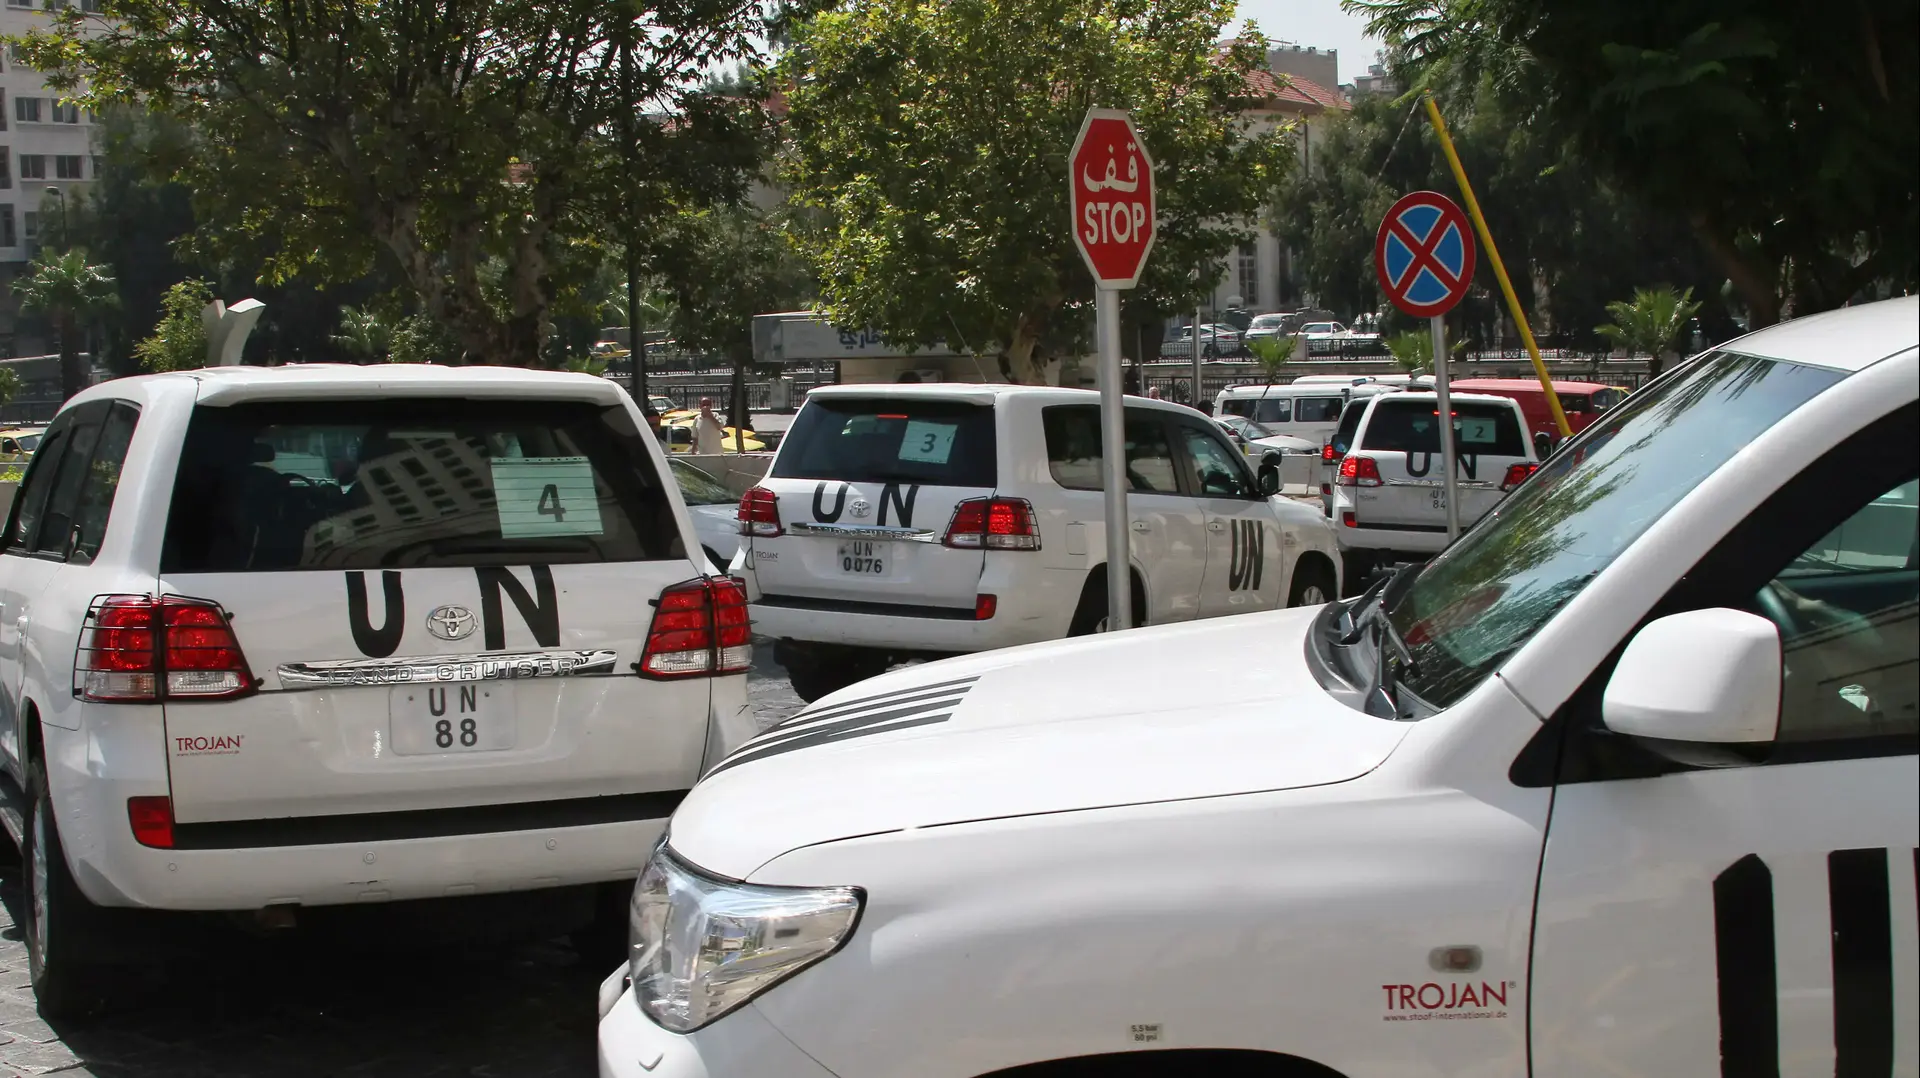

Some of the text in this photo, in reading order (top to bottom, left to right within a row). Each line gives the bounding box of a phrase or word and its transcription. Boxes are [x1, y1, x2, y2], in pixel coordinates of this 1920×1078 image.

[1084, 142, 1137, 192] قف
[1085, 202, 1145, 245] STOP
[920, 433, 937, 453] 3
[1475, 425, 1485, 438] 2
[537, 483, 567, 522] 4
[843, 558, 882, 574] 0076
[1229, 519, 1264, 591] UN
[326, 659, 577, 687] LAND CRUISER
[435, 718, 478, 748] 88
[1382, 1011, 1507, 1022] www.stoof-international.de
